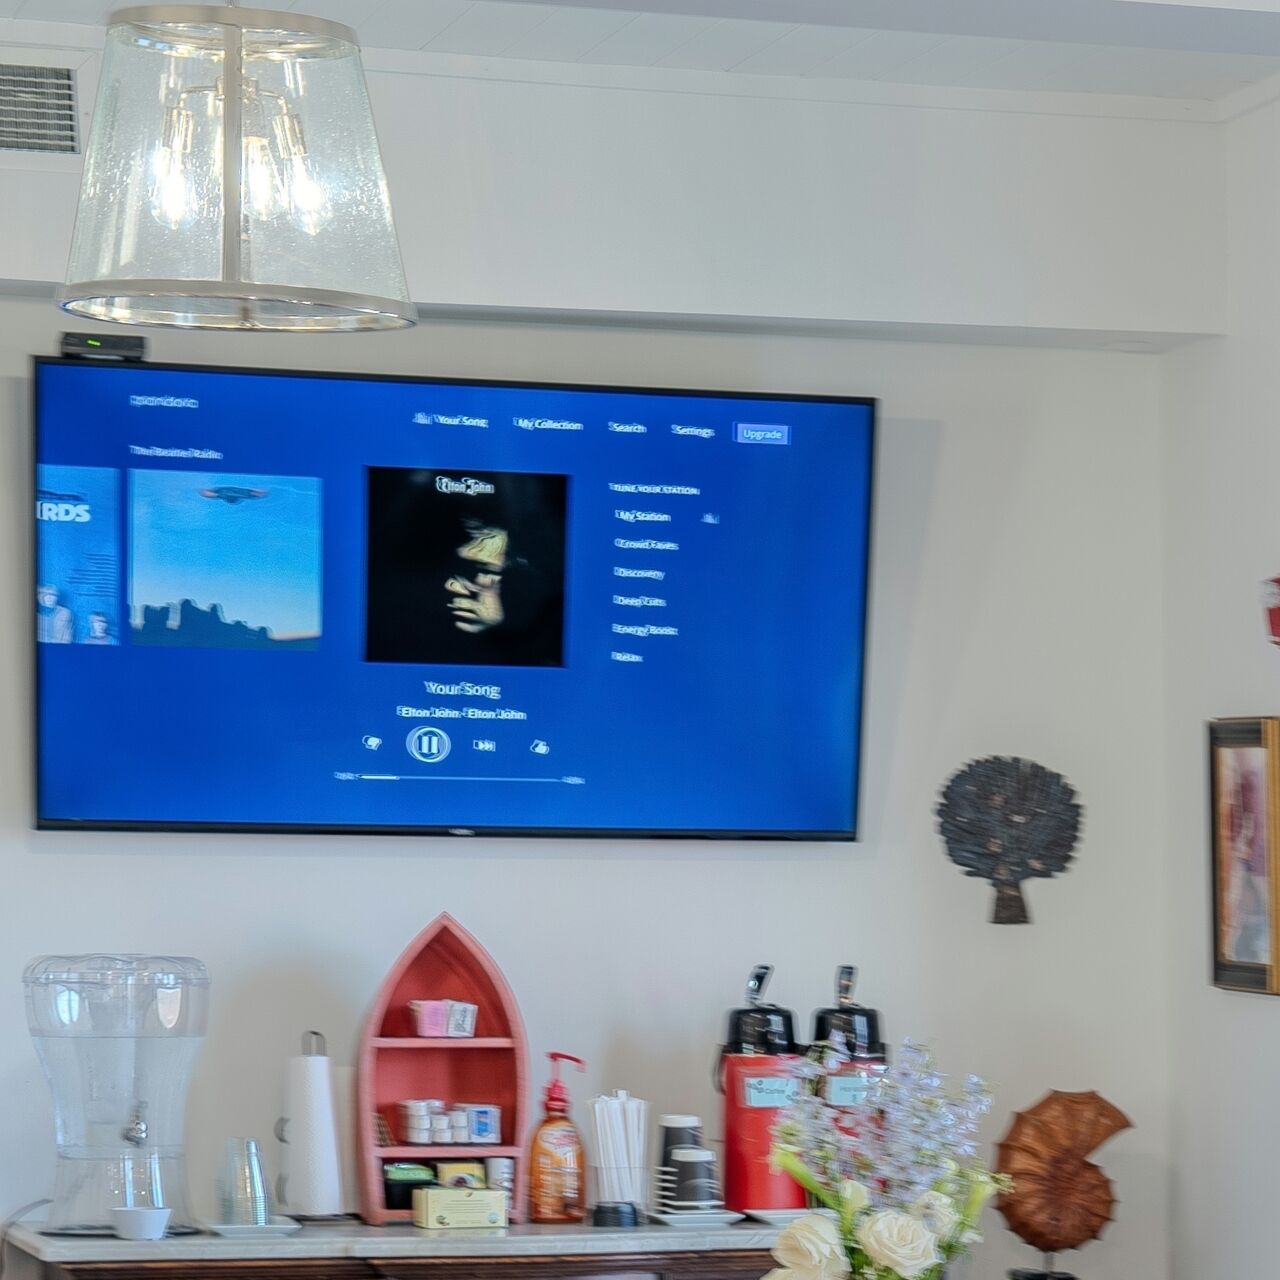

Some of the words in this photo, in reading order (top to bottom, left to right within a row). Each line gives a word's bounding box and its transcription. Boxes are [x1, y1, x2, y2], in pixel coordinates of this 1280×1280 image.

[433, 414, 461, 426] Your
[513, 417, 534, 430] My
[534, 417, 584, 430] Collection
[608, 421, 648, 433] Search
[743, 429, 783, 441] Upgrade
[636, 511, 671, 522] Station
[424, 681, 461, 696] Your
[460, 681, 502, 699] Song
[396, 705, 430, 718] Elton
[430, 706, 460, 718] John
[463, 706, 496, 719] Elton
[496, 708, 528, 720] John
